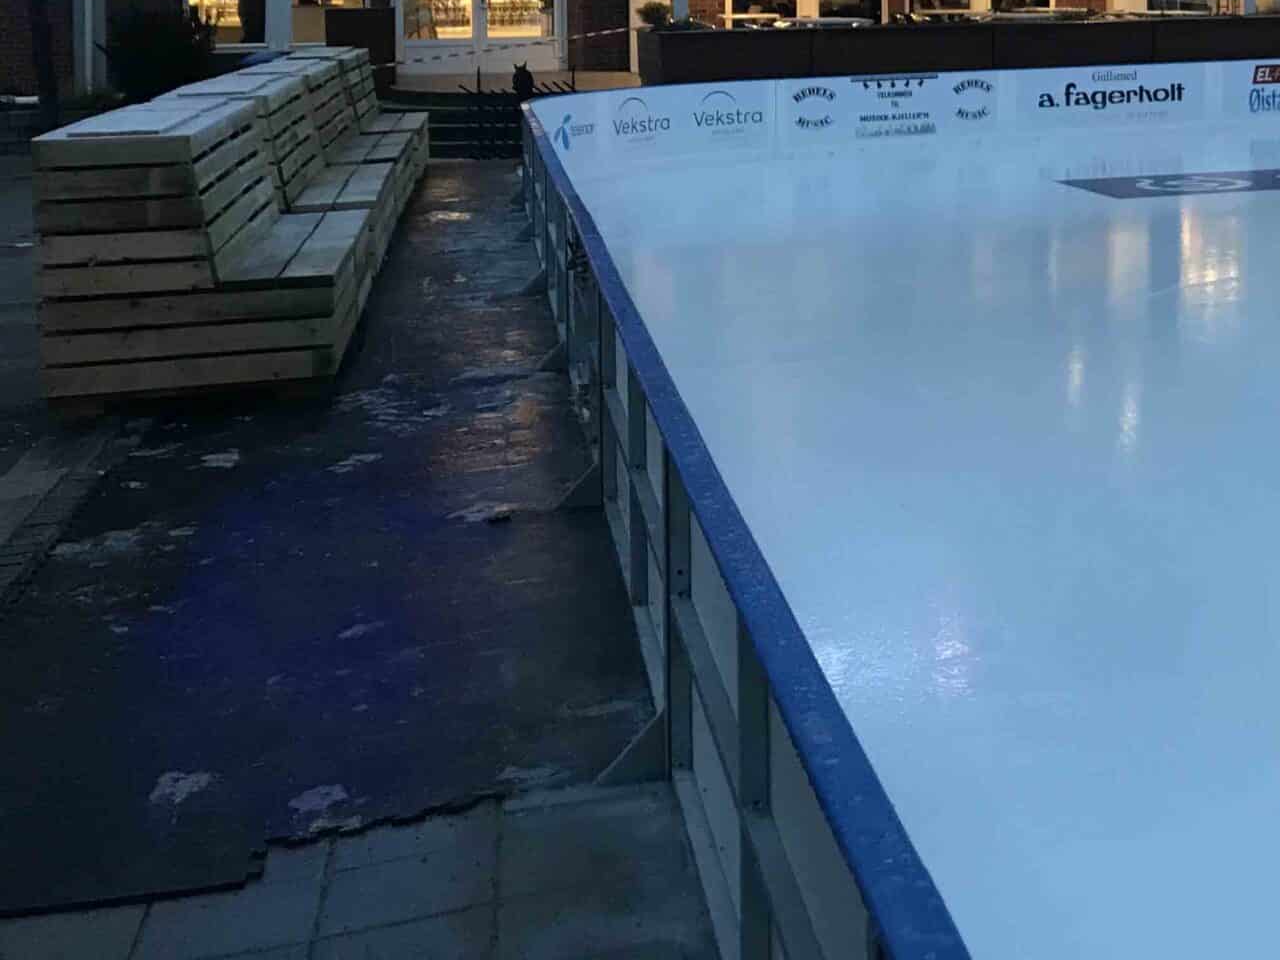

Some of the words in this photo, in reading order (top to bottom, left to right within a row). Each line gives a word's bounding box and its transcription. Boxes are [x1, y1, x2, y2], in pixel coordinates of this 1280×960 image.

[1064, 83, 1185, 110] fagerholt
[613, 117, 671, 136] Vekstra
[693, 108, 762, 127] Vekstra
